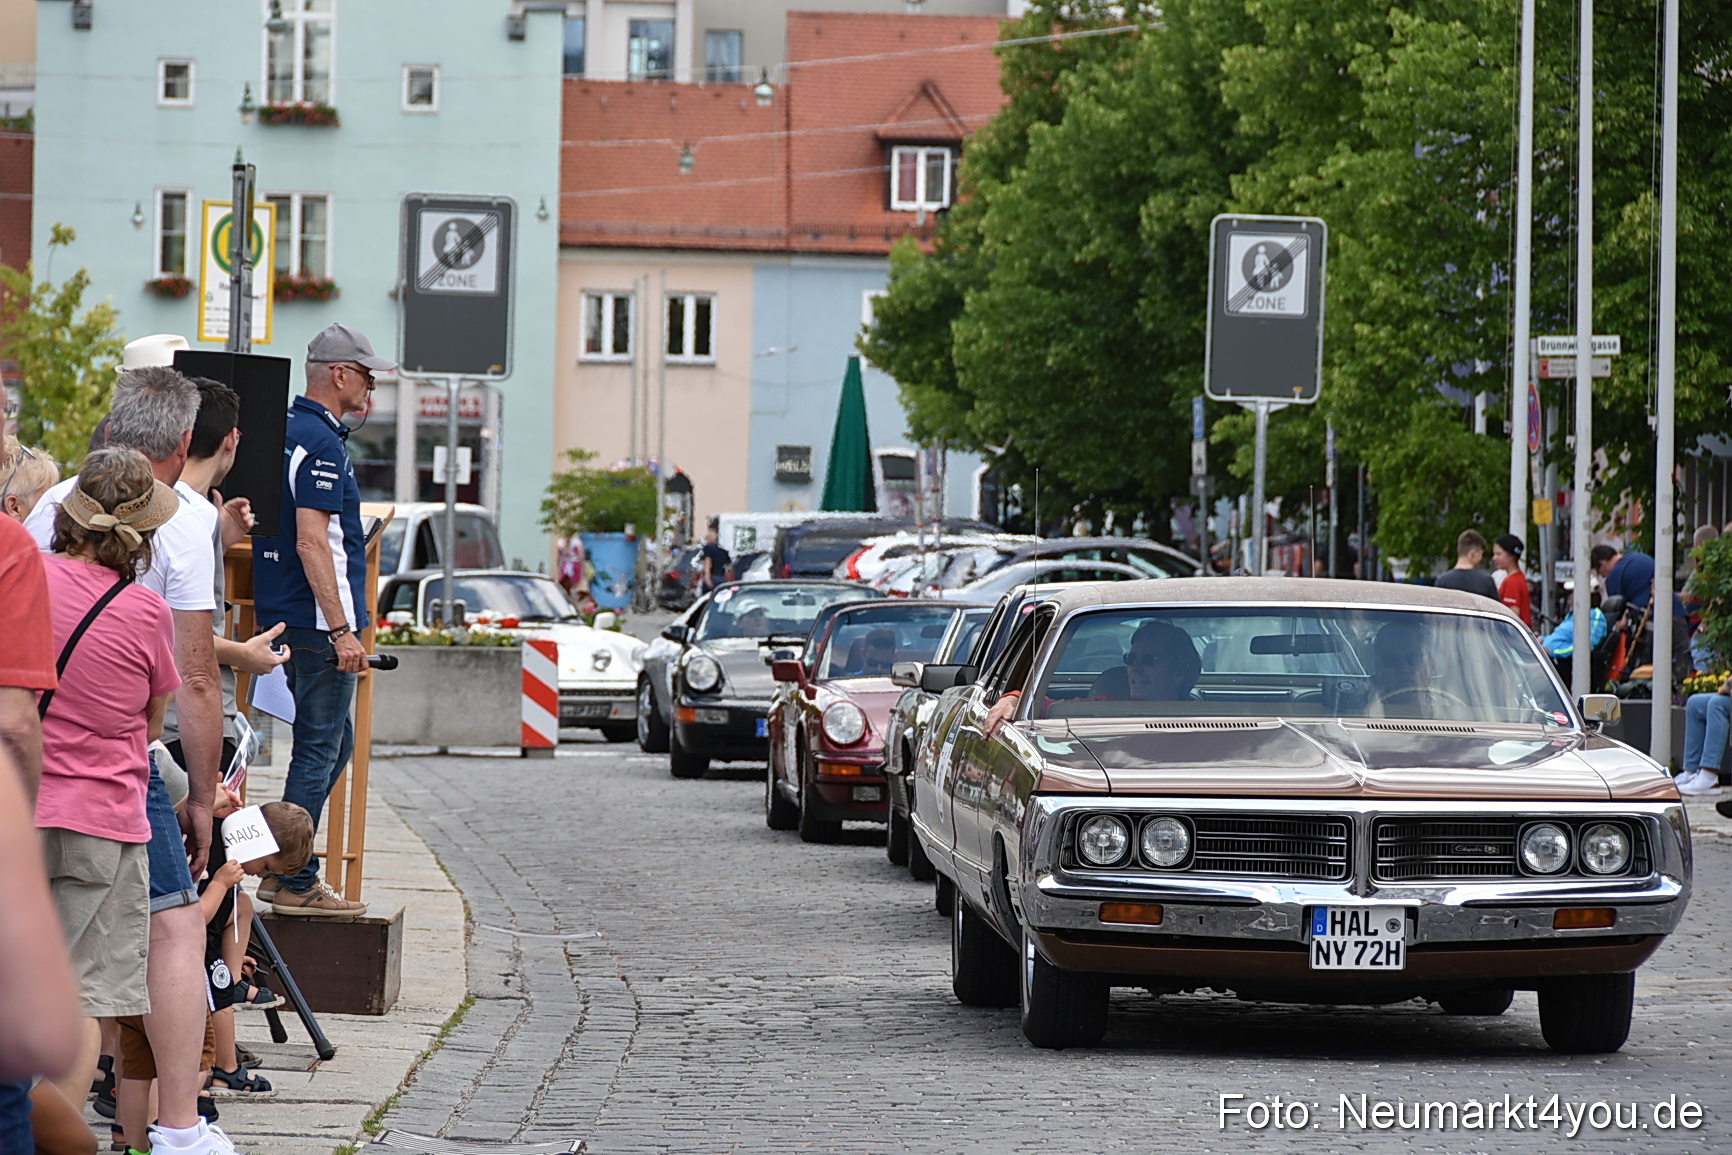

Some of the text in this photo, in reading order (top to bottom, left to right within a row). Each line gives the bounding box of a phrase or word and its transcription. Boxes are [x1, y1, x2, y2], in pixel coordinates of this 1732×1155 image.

[437, 273, 478, 288] ZONE
[1246, 295, 1286, 311] ZONE
[1316, 924, 1324, 933] D
[1330, 910, 1379, 937] HAL
[1315, 940, 1400, 966] NY 72H
